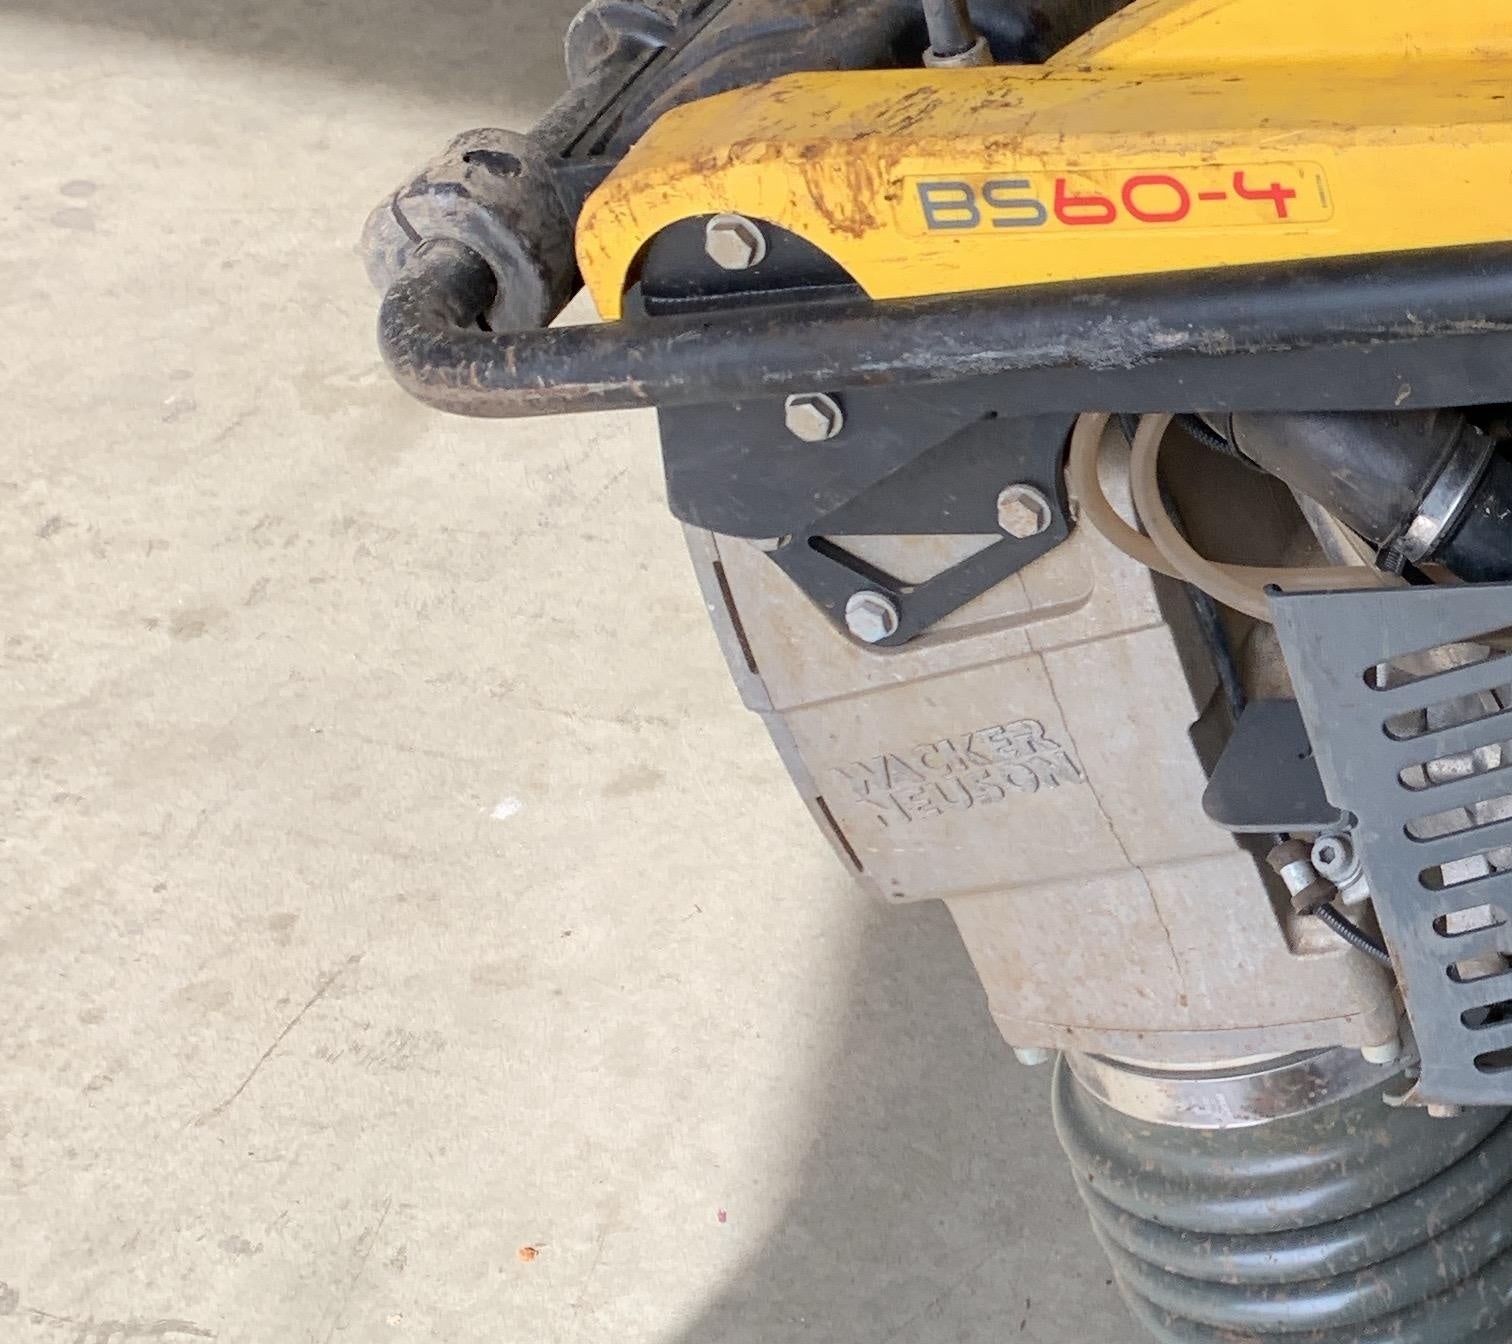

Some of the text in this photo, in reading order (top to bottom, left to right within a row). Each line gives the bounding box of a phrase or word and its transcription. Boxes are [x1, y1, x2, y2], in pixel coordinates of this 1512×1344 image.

[916, 170, 1297, 230] BS60-4
[831, 718, 1064, 797] WACKER
[856, 753, 1087, 829] NEUSON
